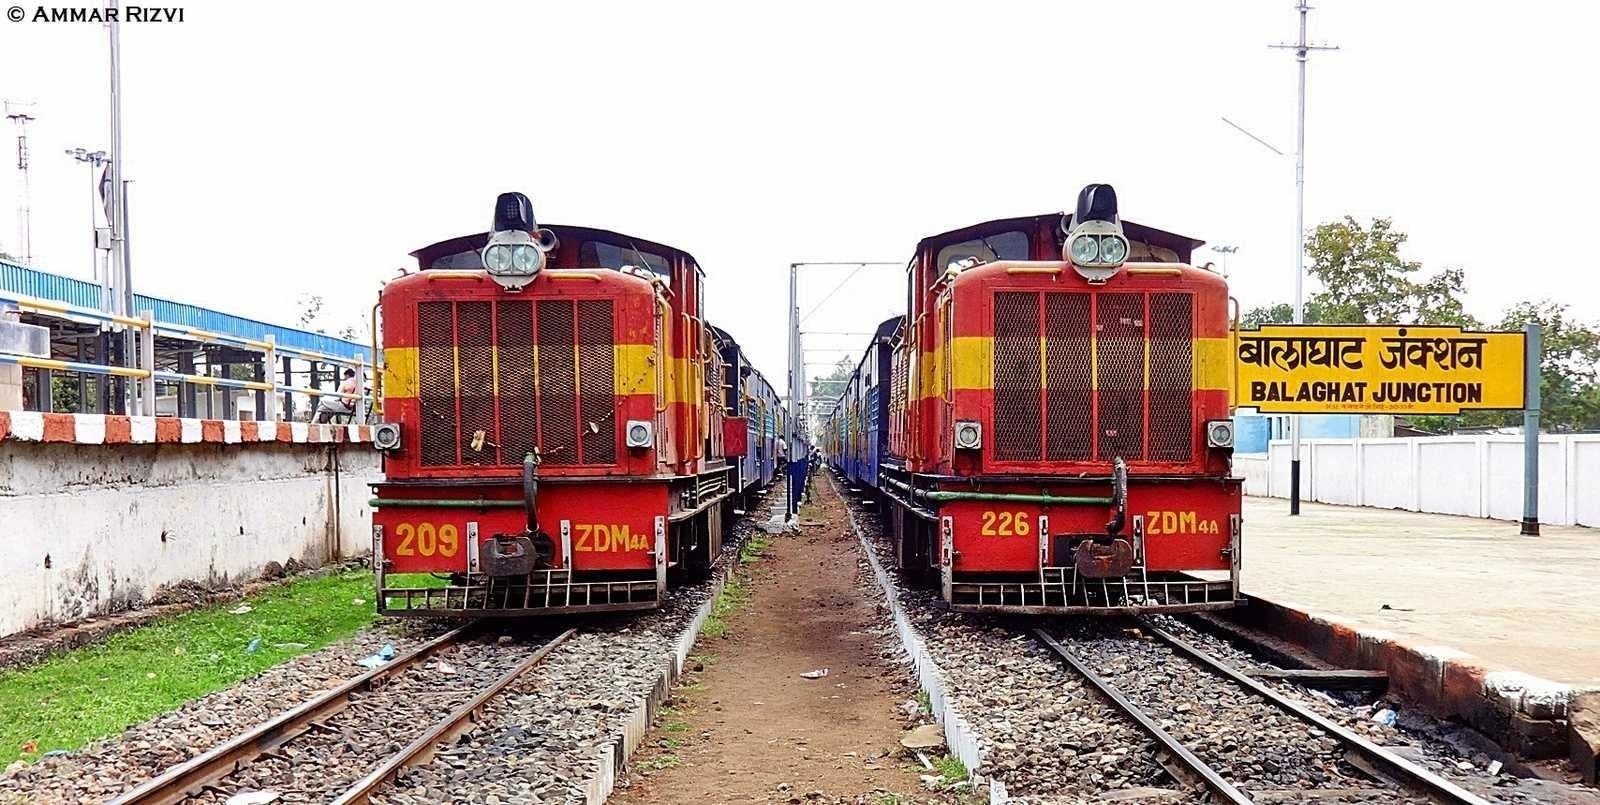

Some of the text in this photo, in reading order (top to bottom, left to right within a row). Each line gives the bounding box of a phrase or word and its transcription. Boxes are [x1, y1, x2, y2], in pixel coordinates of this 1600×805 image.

[1238, 328, 1488, 371] बालाघाट जंक्शन
[1251, 381, 1482, 403] BALAGHAT JUNCTION
[981, 511, 1030, 536] 226
[395, 523, 458, 557] 209
